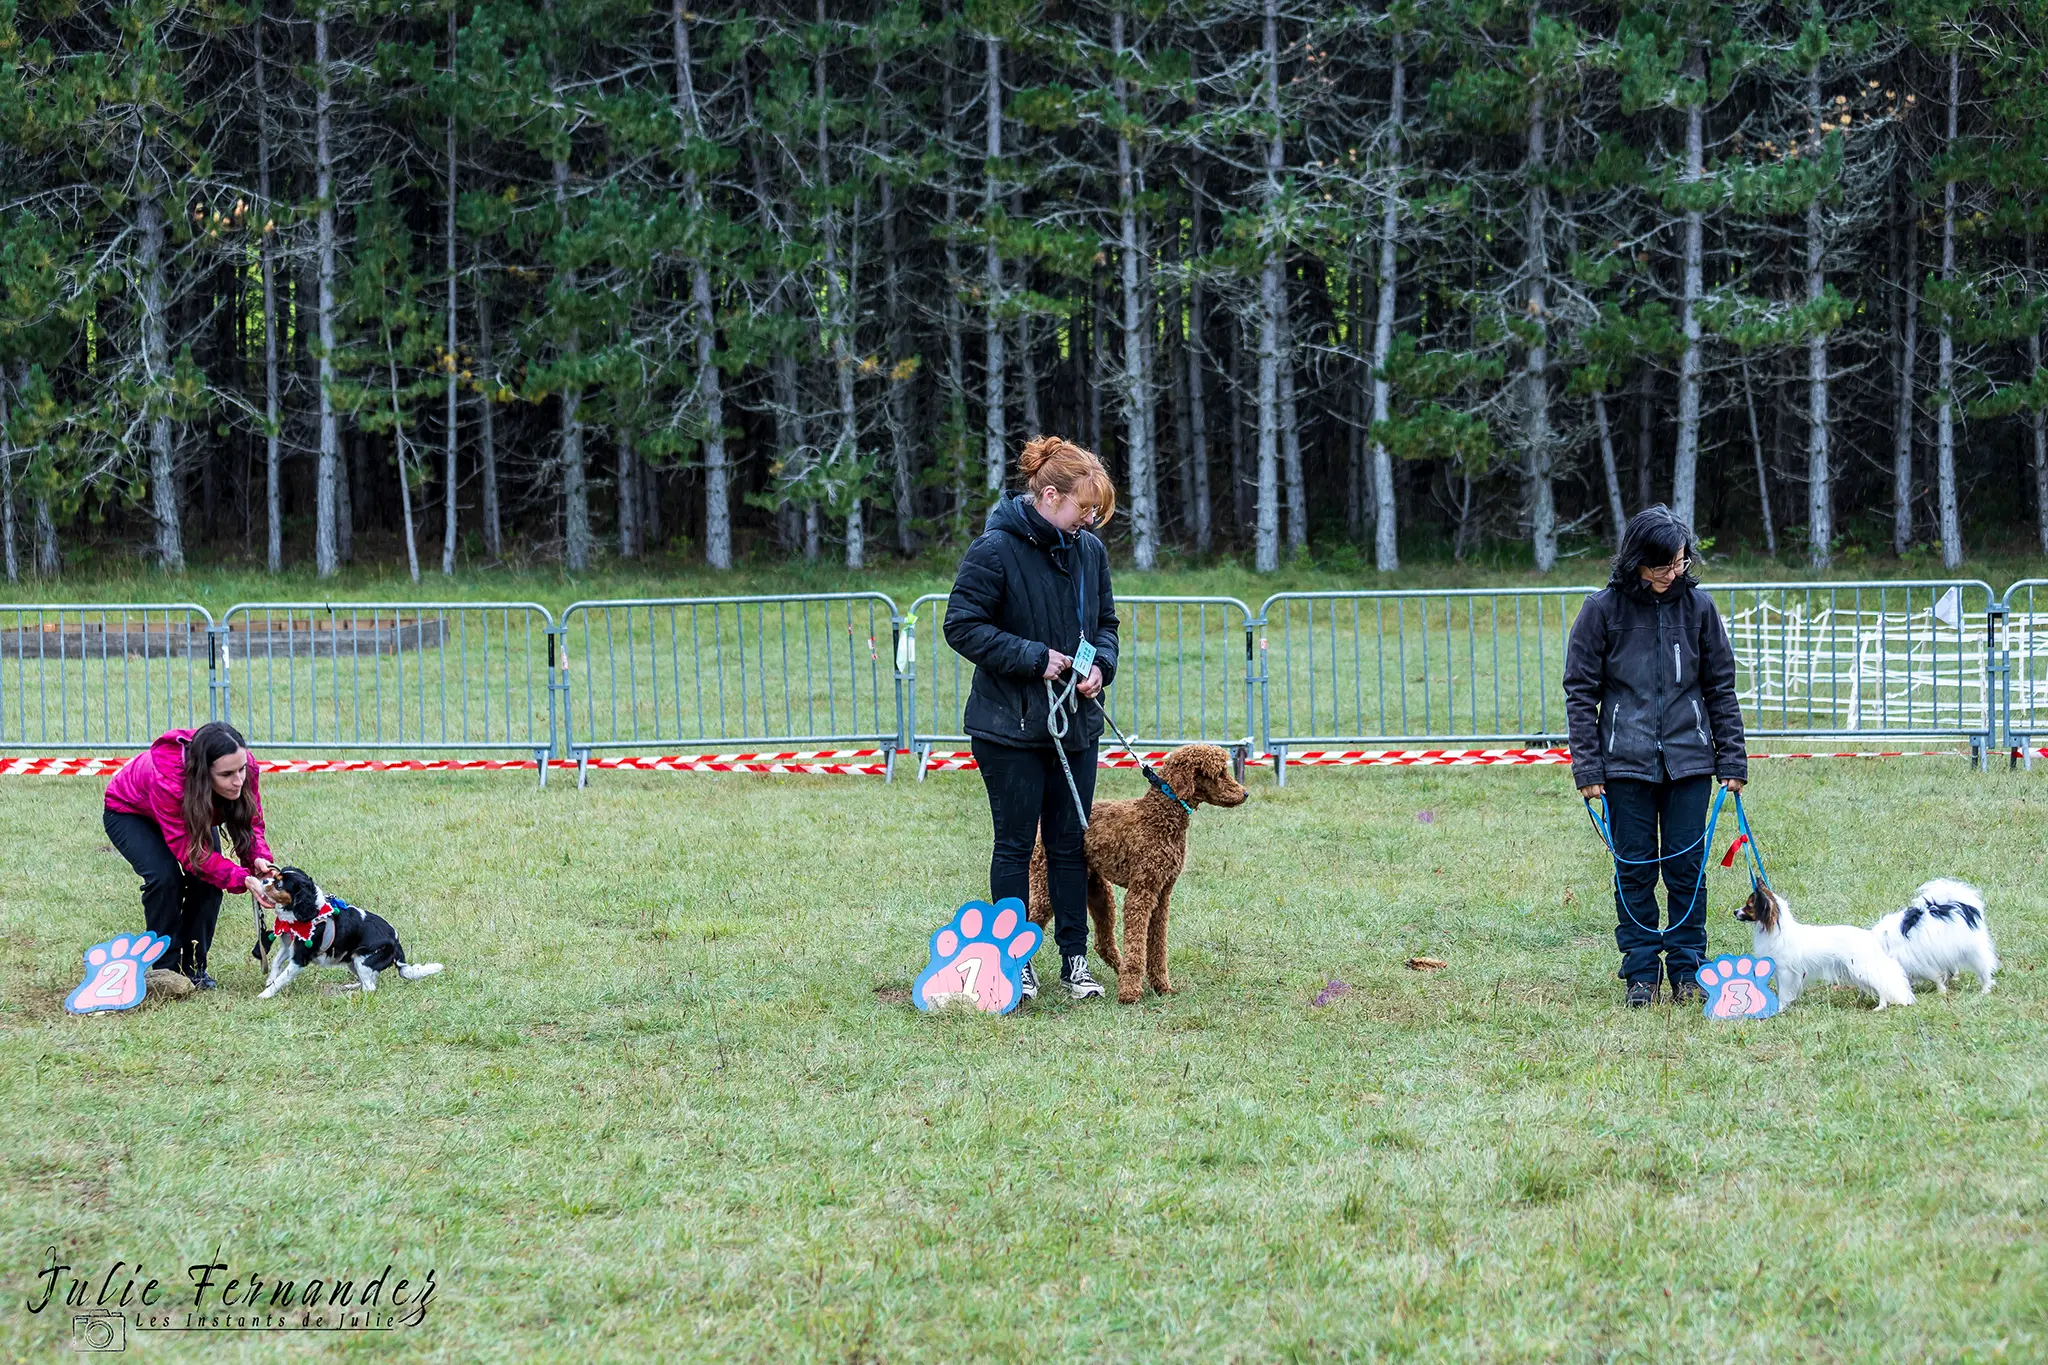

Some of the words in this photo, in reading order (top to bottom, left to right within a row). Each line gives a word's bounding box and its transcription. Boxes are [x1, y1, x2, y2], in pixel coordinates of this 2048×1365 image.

[95, 962, 129, 998] 2
[955, 957, 984, 1003] 1
[1728, 983, 1752, 1014] 3
